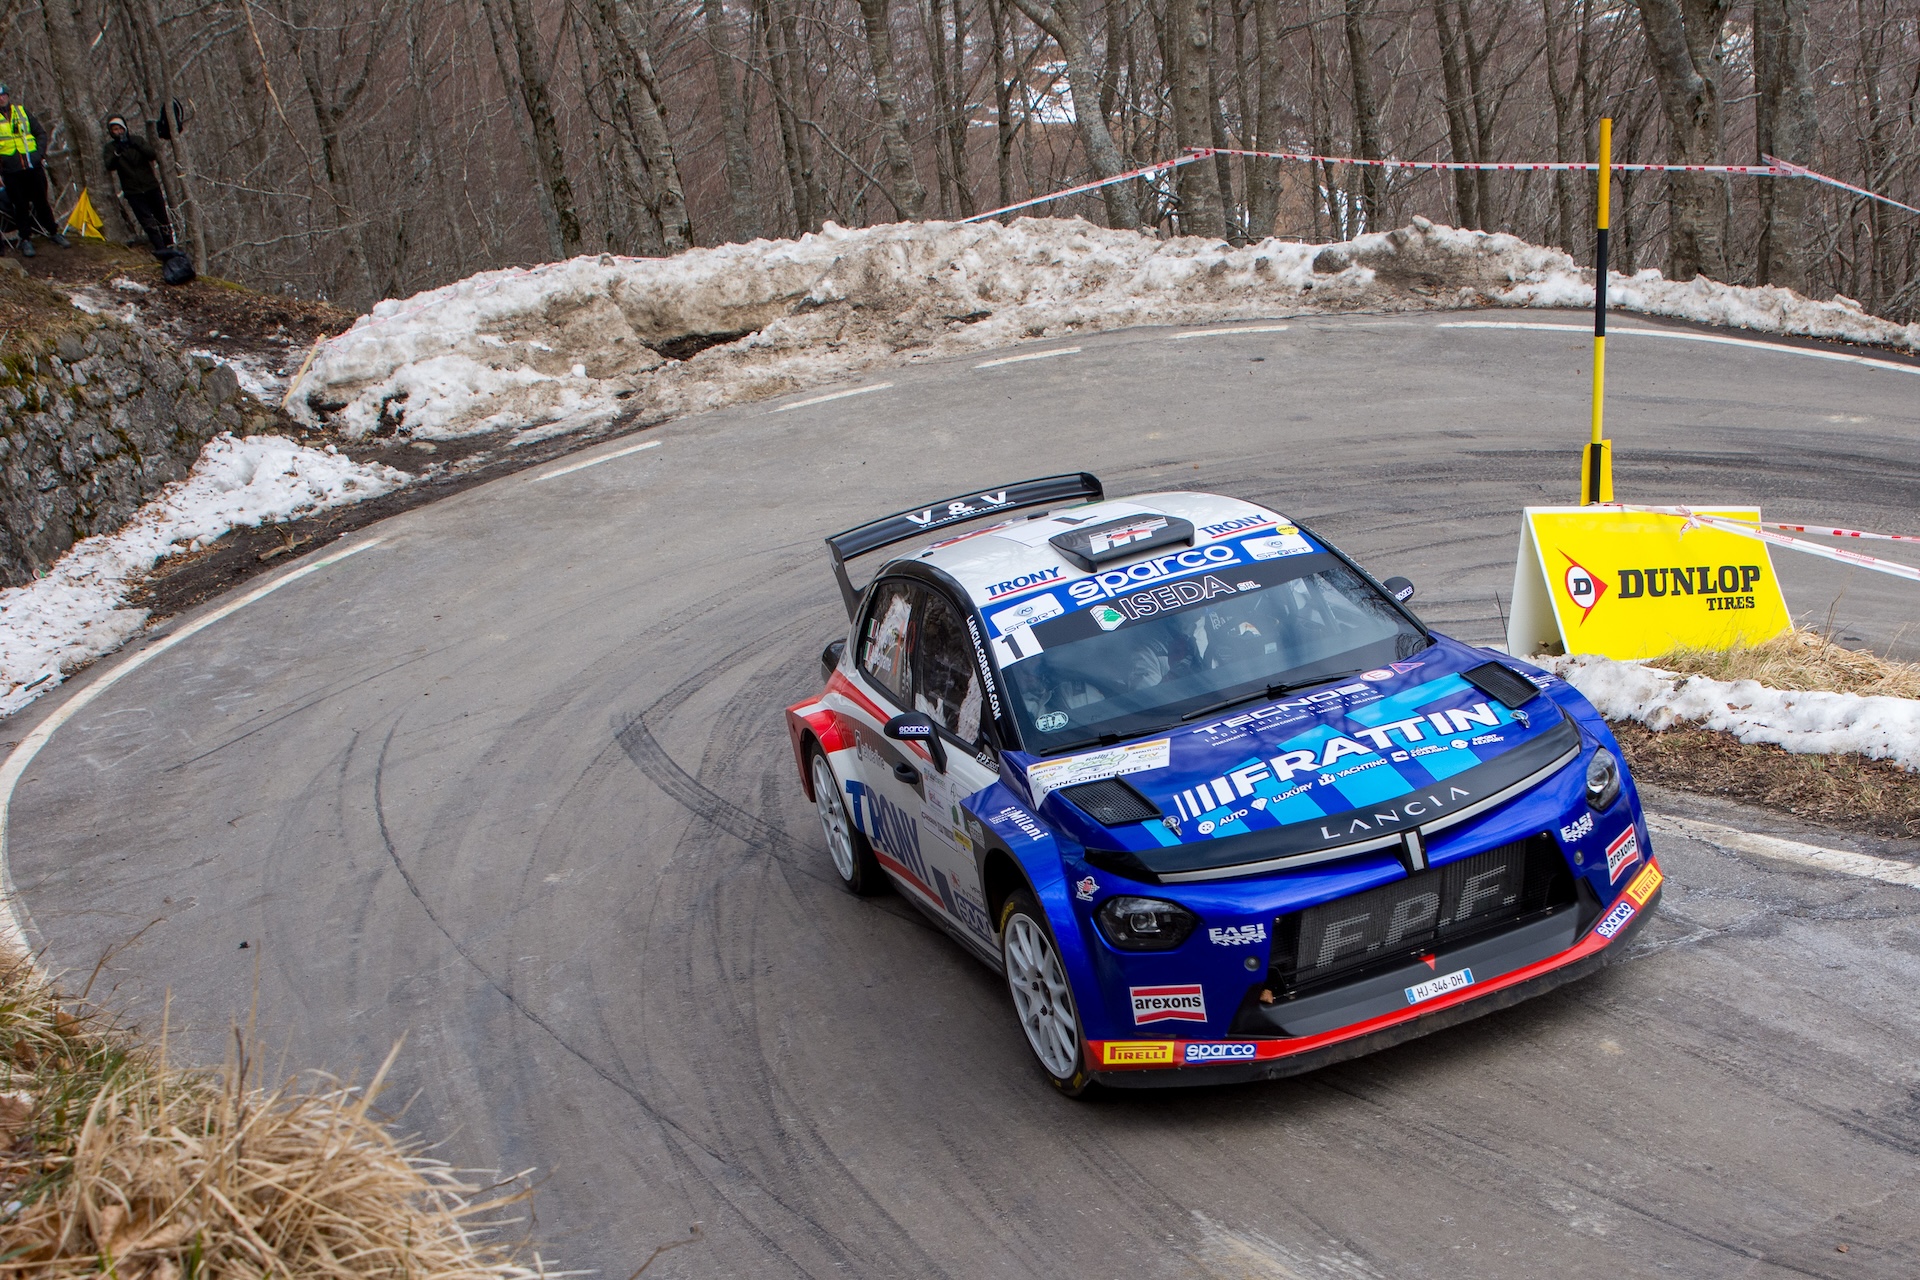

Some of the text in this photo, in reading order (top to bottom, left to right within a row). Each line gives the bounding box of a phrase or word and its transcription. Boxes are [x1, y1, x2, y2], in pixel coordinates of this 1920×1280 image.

[906, 491, 1006, 524] V & V
[1198, 514, 1268, 535] TRONY
[1256, 546, 1308, 559] SPORT
[985, 566, 1059, 596] TRONY
[1068, 545, 1234, 599] sparco
[1617, 565, 1761, 599] DUNLOP
[1119, 574, 1262, 621] ISEDA SRL
[1573, 578, 1591, 596] D
[1706, 595, 1755, 611] TIRES
[1004, 608, 1058, 633] SPORT
[1001, 633, 1025, 660] 1
[898, 726, 929, 734] sparco
[1205, 690, 1378, 743] INDUSTRIAL SOLUTIONS
[1211, 732, 1247, 747] PNEUMATIC
[1226, 702, 1502, 798] FRATTIN
[1042, 767, 1142, 795] CONCORRENTE
[1336, 758, 1389, 778] YACHTING
[1218, 808, 1249, 827] AUTO
[1320, 786, 1470, 840] LANCIA
[846, 780, 932, 888] TRONY
[1609, 836, 1635, 869] arexons
[1631, 868, 1659, 900] PIRELLI
[1208, 923, 1267, 941] EASI
[1597, 902, 1632, 937] sparco
[1416, 974, 1464, 998] HJ-346-DH
[1134, 995, 1202, 1010] arexons
[1110, 1044, 1256, 1060] PIRELLI sparco
